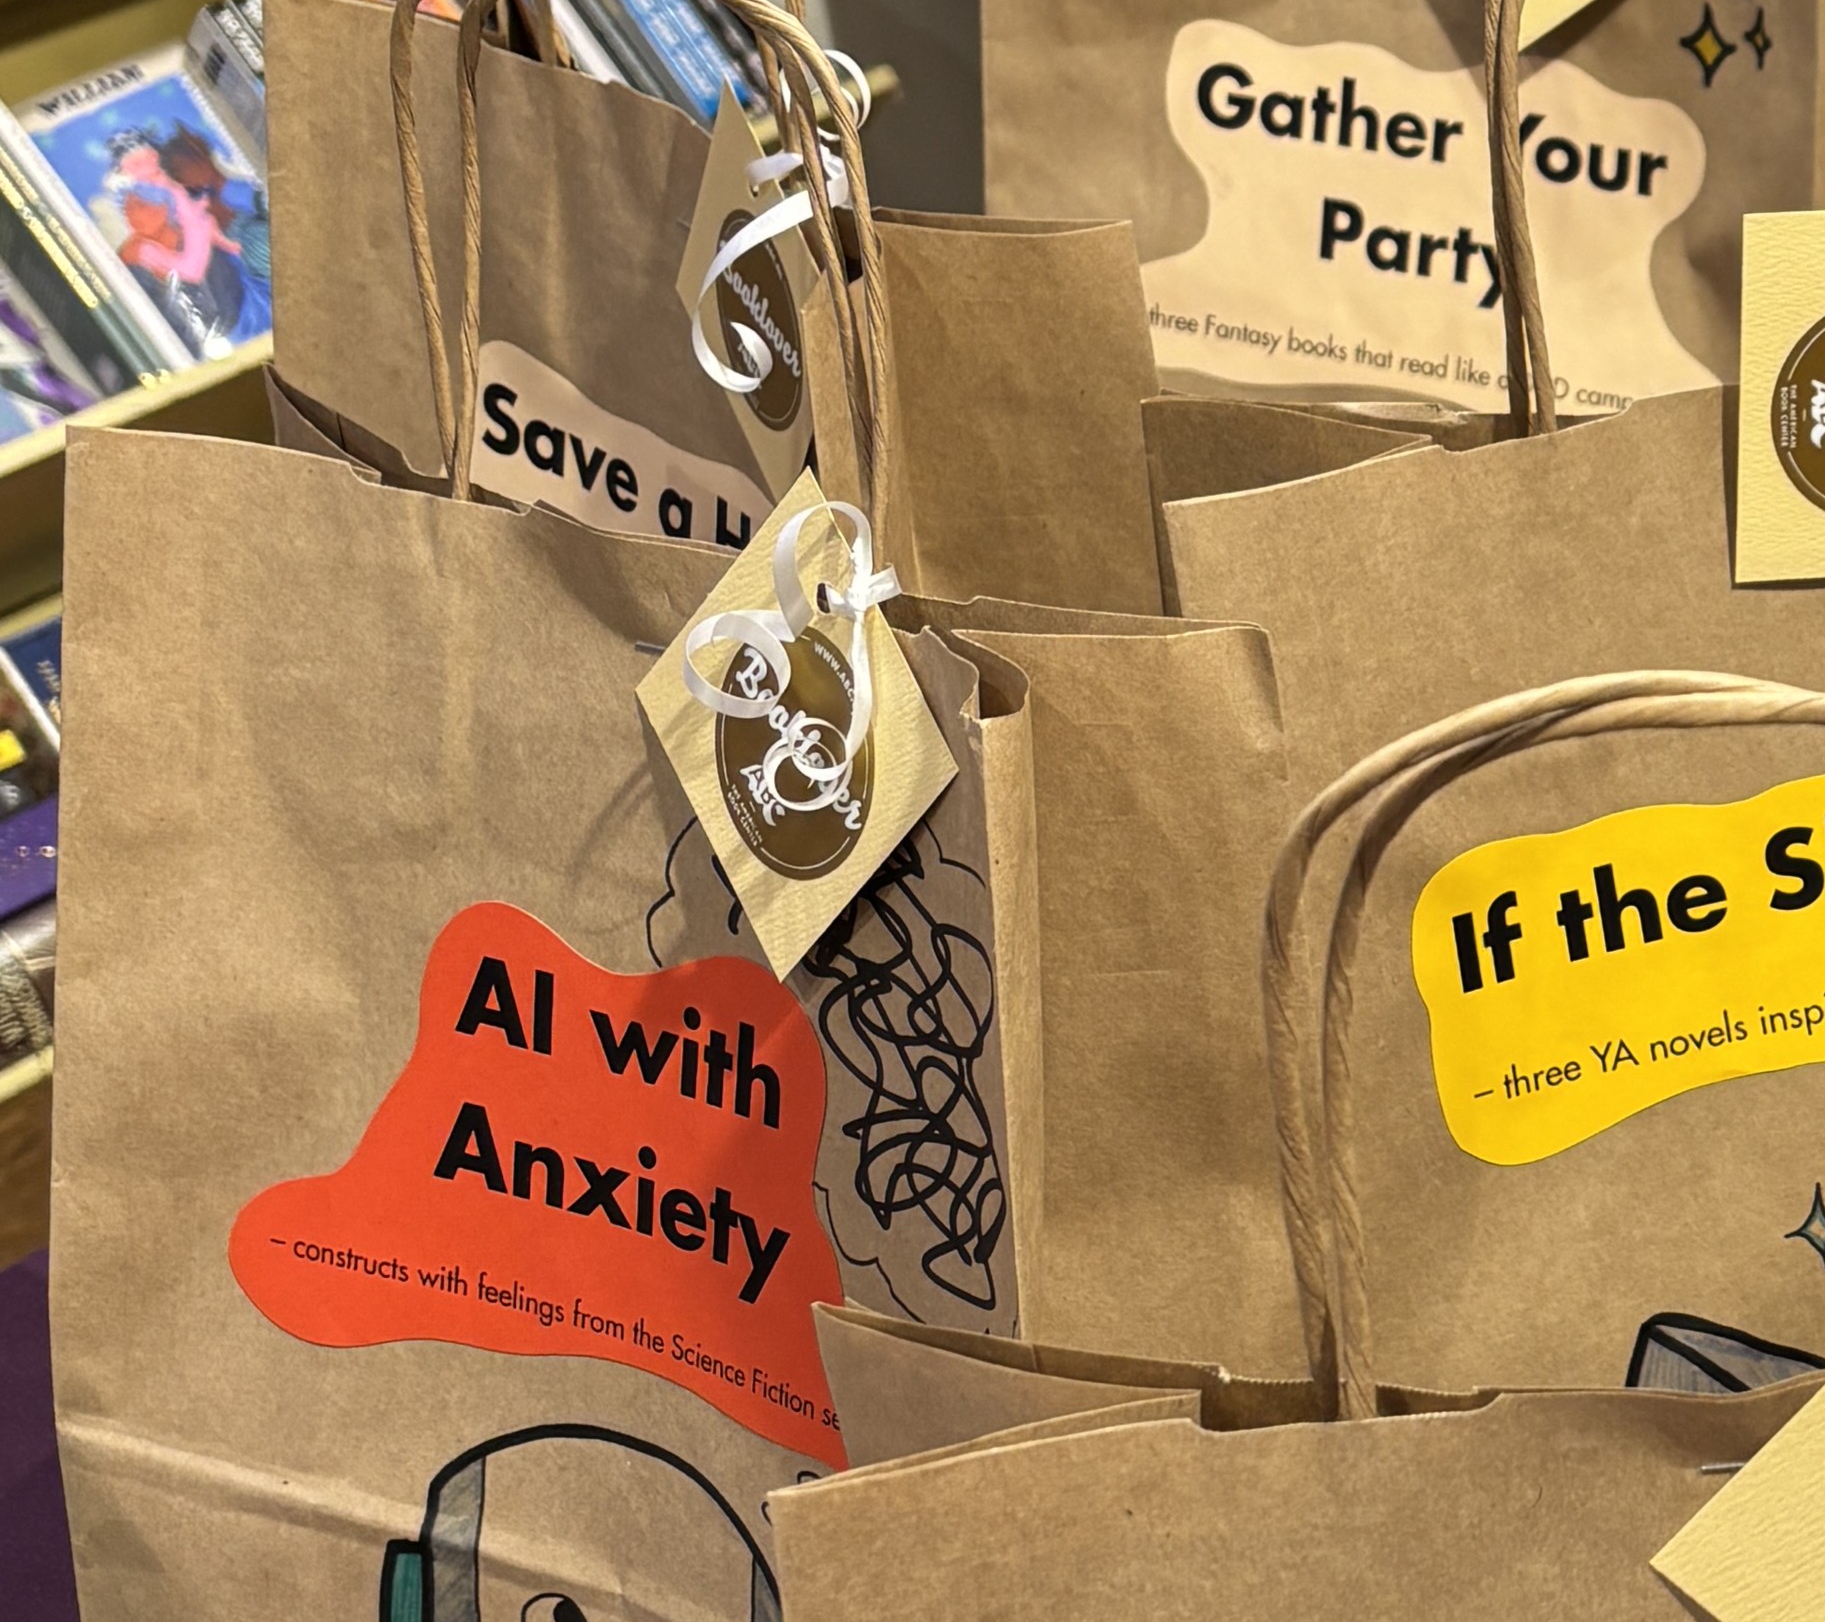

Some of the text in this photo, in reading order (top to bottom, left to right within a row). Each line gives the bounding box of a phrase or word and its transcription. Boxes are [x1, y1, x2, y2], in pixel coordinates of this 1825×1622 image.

[1196, 62, 1464, 165] Gather
[1318, 196, 1502, 309] Party
[1148, 308, 1199, 336] three
[1205, 314, 1281, 354] Fantasy
[1287, 326, 1348, 363] books
[1355, 340, 1393, 370] that
[1400, 354, 1449, 380] read
[1456, 356, 1491, 388] like
[481, 382, 640, 514] Save
[814, 641, 855, 703] WWW.ABC
[1451, 890, 1524, 996] If
[1556, 863, 1730, 965] the
[455, 955, 782, 1131] AI with
[1504, 1061, 1582, 1101] three
[1589, 1038, 1640, 1074] YA
[1648, 1009, 1749, 1064] novels
[432, 1101, 792, 1305] Anxiety
[292, 1238, 816, 1422] constructs with feelings from the Science Fiction
